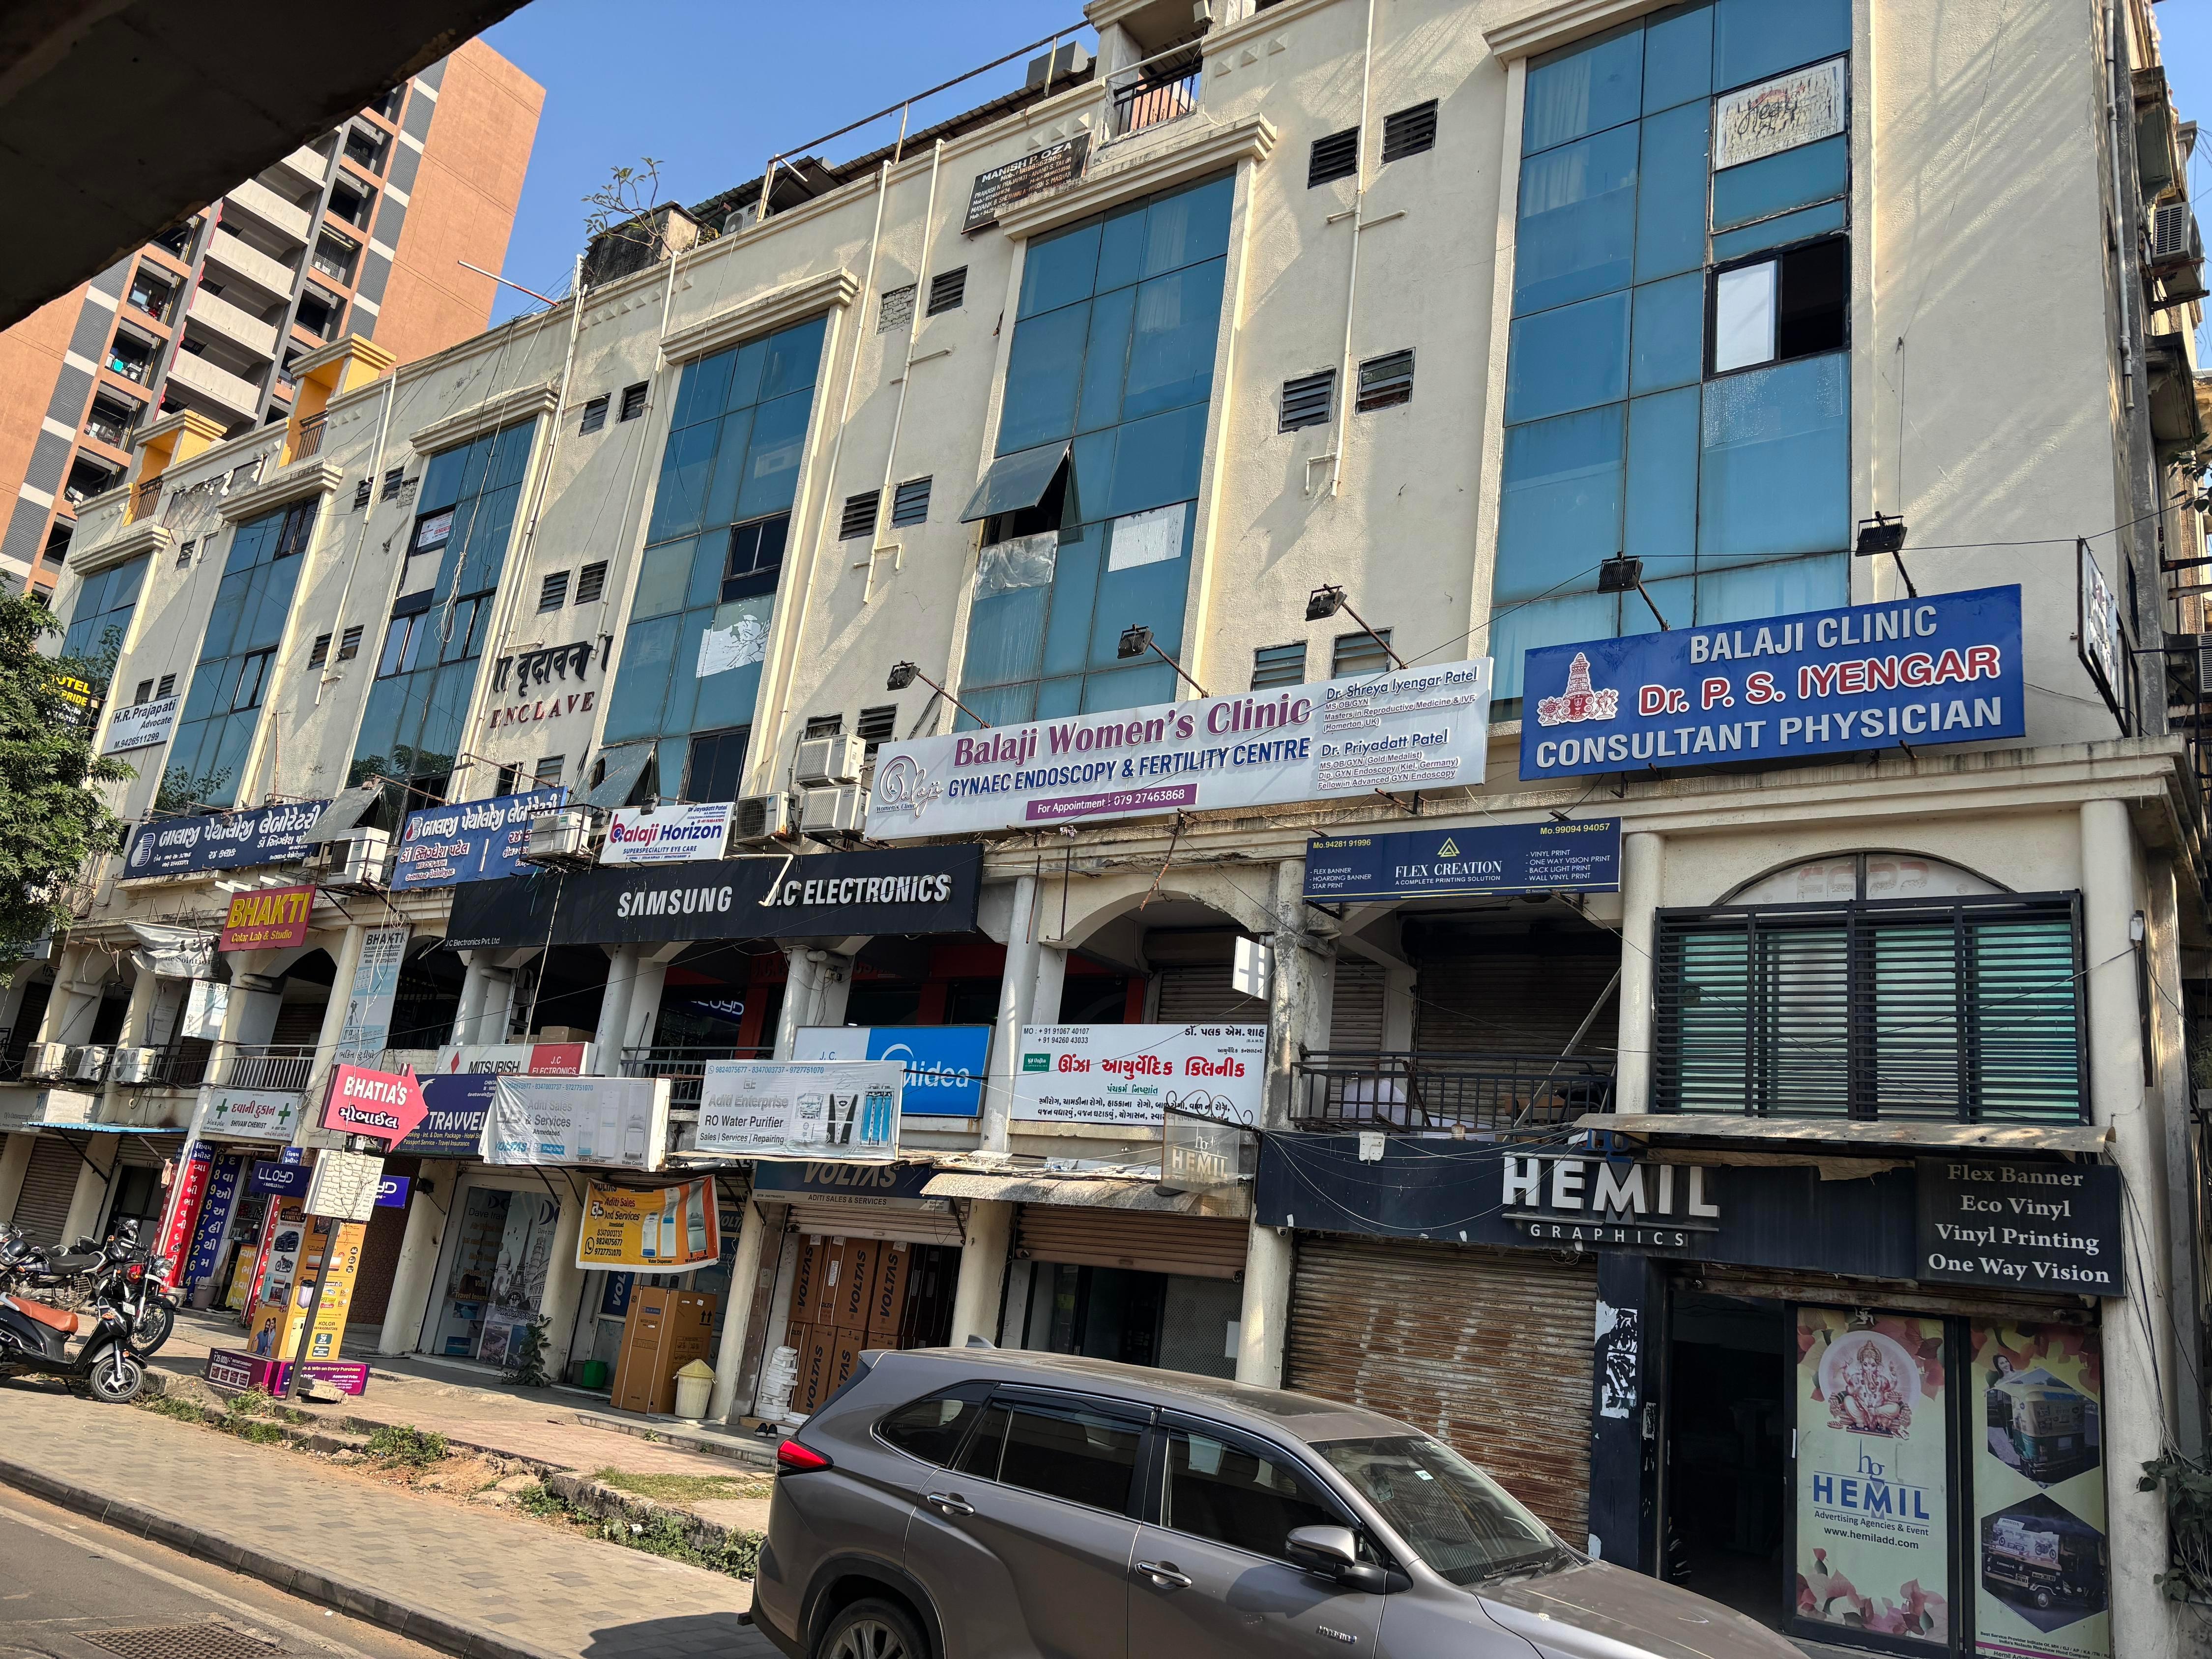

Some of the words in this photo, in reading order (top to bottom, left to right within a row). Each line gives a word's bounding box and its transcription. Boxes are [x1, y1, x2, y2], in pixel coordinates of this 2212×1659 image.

[982, 160, 1027, 182] MANISH
[1041, 142, 1072, 159] OZA
[975, 186, 996, 198] PRAKASH
[1003, 175, 1027, 187] PRAJAPATI
[971, 202, 992, 213] MAYANK
[1690, 622, 1803, 665] BALAJI
[1817, 606, 1937, 648] CLINIC
[1326, 688, 1343, 700] Dr.
[1347, 684, 1388, 699] Shreya
[1393, 677, 1442, 695] Iyengar
[1444, 666, 1478, 685] Patel
[1639, 684, 1688, 716] Dr.
[1701, 677, 1734, 710] P.
[1746, 671, 1785, 704] S.
[1798, 645, 2001, 699] IYENGAR
[114, 710, 130, 724] H.R.
[132, 699, 176, 720] Prajapati
[490, 691, 595, 728] ENCLAVE
[1324, 712, 1353, 722] Masters
[1363, 704, 1415, 717] Reproductive
[1416, 699, 1451, 709] Medicine
[141, 716, 172, 729] Advocate
[953, 727, 1038, 767] Balaji
[1049, 709, 1195, 756] Women's
[1207, 693, 1312, 735] Clinic
[1536, 720, 1766, 768] CONSULTANT
[1779, 697, 2001, 746] PHYSICIAN
[1321, 744, 1340, 758] Dr.
[1344, 736, 1409, 756] Priyadatt
[1412, 728, 1449, 747] Patel
[948, 773, 1012, 798] GYNAEC
[1015, 760, 1117, 790] ENDOSCOPY
[1122, 758, 1134, 778] &
[1138, 747, 1229, 777] FERTILITY
[1232, 737, 1311, 767] CENTRE
[1353, 766, 1396, 777] Endoscopy
[1037, 803, 1051, 814] For
[1052, 799, 1106, 813] Appointment
[1114, 795, 1132, 806] 079
[1135, 789, 1185, 804] 27463868
[159, 826, 201, 848] બાલાજી
[258, 804, 321, 834] લેબોરેટરી
[422, 817, 459, 838] બાલાજી
[461, 804, 504, 831] પેથોલોજી
[659, 821, 722, 841] Horizon
[1541, 826, 1581, 835] Mo.99094
[1583, 823, 1610, 832] 94057
[449, 840, 470, 855] પટેલ
[1395, 865, 1428, 877] FLEX
[1434, 861, 1503, 876] CREATION
[617, 886, 733, 918] SAMSUNG
[802, 873, 952, 906] ELECTRONICS
[227, 893, 311, 929] BHAKTI
[250, 931, 262, 941] Lab
[270, 930, 292, 940] Studio
[366, 932, 404, 945] BHAKTI
[195, 981, 230, 992] BHAKTI
[1247, 1028, 1264, 1037] શાહ
[468, 1061, 521, 1074] MITSUBISH
[532, 1067, 576, 1075] ELECTRONICS
[551, 1056, 561, 1065] J.C
[1058, 1053, 1091, 1073] ઊંઝા
[1102, 1055, 1173, 1080] આયુર્વેદિક
[343, 1076, 408, 1106] BHATIA'S
[1106, 1083, 1128, 1093] પંચકર્મ
[232, 1100, 255, 1114] દવાની
[256, 1106, 276, 1119] દુકાન
[339, 1105, 399, 1129] મોબાઈલ
[429, 1112, 485, 1131] TRAVVEL
[535, 1115, 571, 1128] Services
[705, 1115, 719, 1126] RO
[722, 1115, 748, 1127] Water
[750, 1115, 784, 1128] Purifier
[196, 1142, 212, 1151] શિવમ
[700, 1133, 717, 1141] Sales
[753, 1135, 784, 1145] Repairing
[258, 1167, 294, 1183] LLOYD
[803, 1162, 897, 1188] VOLTAS
[1172, 1149, 1228, 1178] HEMIL
[1947, 1164, 1995, 1182] Flex
[2000, 1166, 2084, 1186] Banner
[1502, 1157, 1720, 1218] HEMIL
[468, 1207, 489, 1220] Dave
[620, 1197, 635, 1207] Sales
[1960, 1194, 2002, 1213] Eco
[2008, 1197, 2071, 1221] Vinyl
[604, 1211, 613, 1220] And
[615, 1211, 640, 1221] Services
[1530, 1224, 1684, 1247] GRAPHICS
[1935, 1223, 1996, 1247] Vinyl
[2002, 1228, 2099, 1256] Printing
[797, 1245, 814, 1308] VOLTAS
[1928, 1253, 1974, 1272] One
[1979, 1257, 2028, 1281] Way
[2032, 1261, 2111, 1283] Vision
[849, 1250, 866, 1314] VOLTAS
[880, 1253, 898, 1318] VOLTAS
[806, 1344, 823, 1409] VOLTAS
[1813, 1474, 1929, 1520] HEMIL
[1814, 1510, 1859, 1526] Advertising
[1860, 1517, 1895, 1531] Agencies
[1906, 1525, 1929, 1536] Event
[1824, 1526, 1919, 1549] www.hemiladd.com
